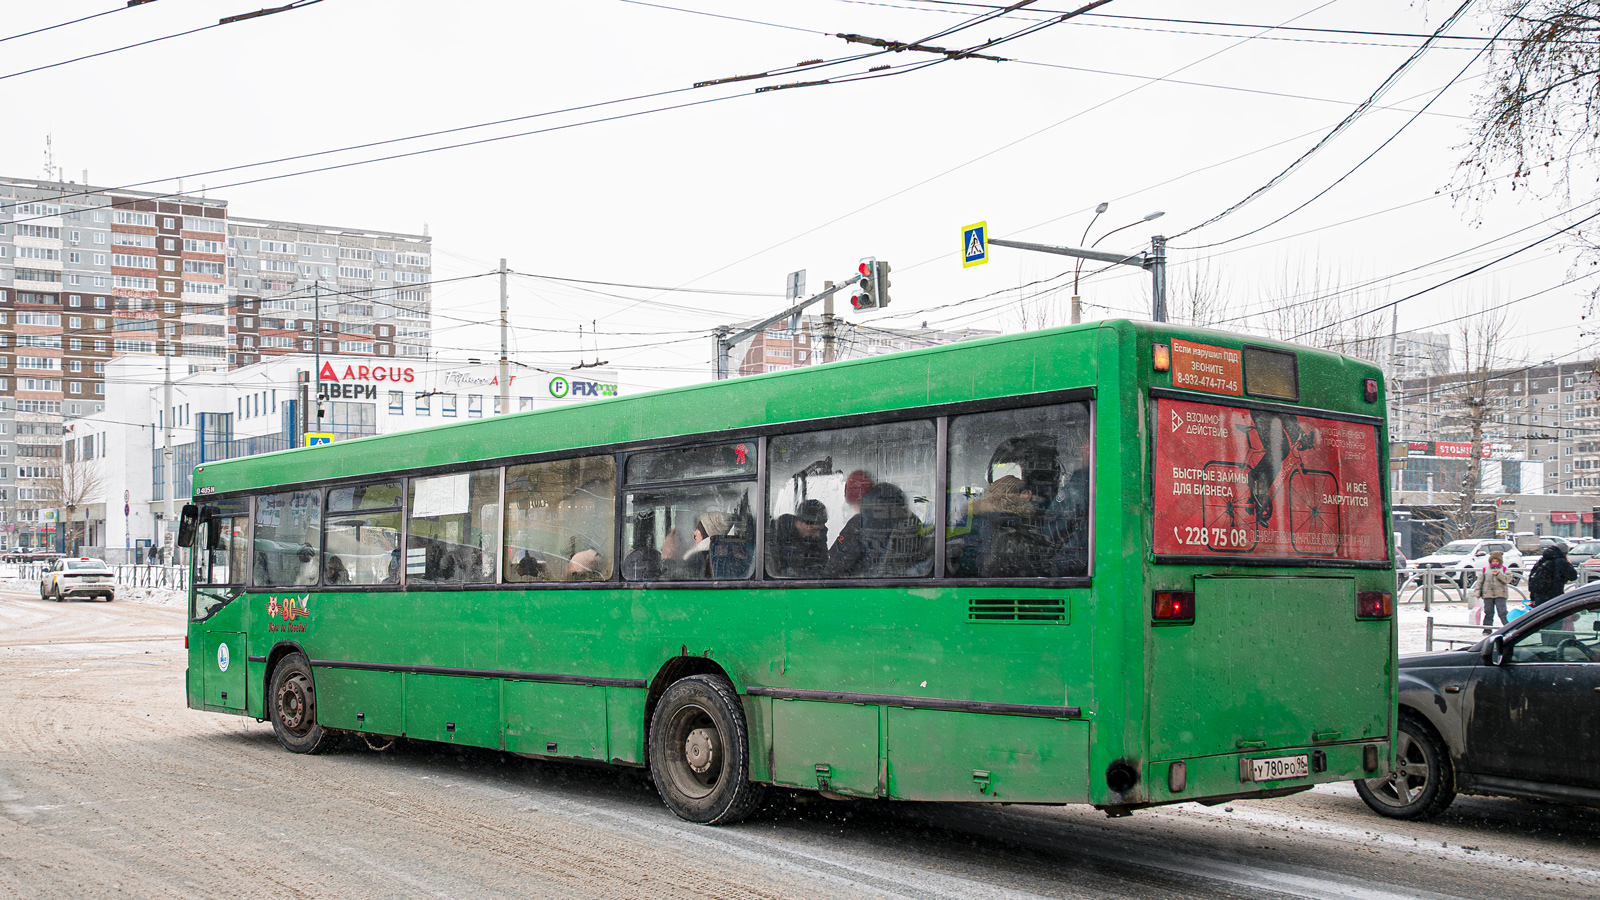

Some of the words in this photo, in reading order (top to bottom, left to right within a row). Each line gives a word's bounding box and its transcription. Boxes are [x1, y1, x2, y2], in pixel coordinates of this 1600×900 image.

[1173, 342, 1192, 354] Если
[1192, 347, 1223, 360] нарушил
[1223, 351, 1239, 364] ПДД
[343, 364, 415, 383] ARGUS
[1190, 361, 1224, 375] ЗВОНИТЕ
[489, 375, 517, 388] AT
[1177, 372, 1238, 391] 8-932-474-77-45
[319, 383, 377, 400] ДВЕРИ
[1439, 445, 1473, 454] STOLNI
[1172, 466, 1215, 481] БЫСТРЫЕ
[1216, 469, 1249, 484] ЗАЙМЫ
[1172, 482, 1192, 495] ДЛЯ
[1193, 483, 1234, 497] БИЗНЕСА
[1346, 482, 1352, 492] И
[1353, 481, 1367, 493] ВСЁ
[1322, 493, 1369, 507] ЗАКРУТИТСЯ
[1185, 526, 1209, 545] 228
[1211, 528, 1227, 546] 75
[1230, 529, 1247, 547] 08
[282, 597, 296, 621] 80
[1296, 757, 1305, 769] 96
